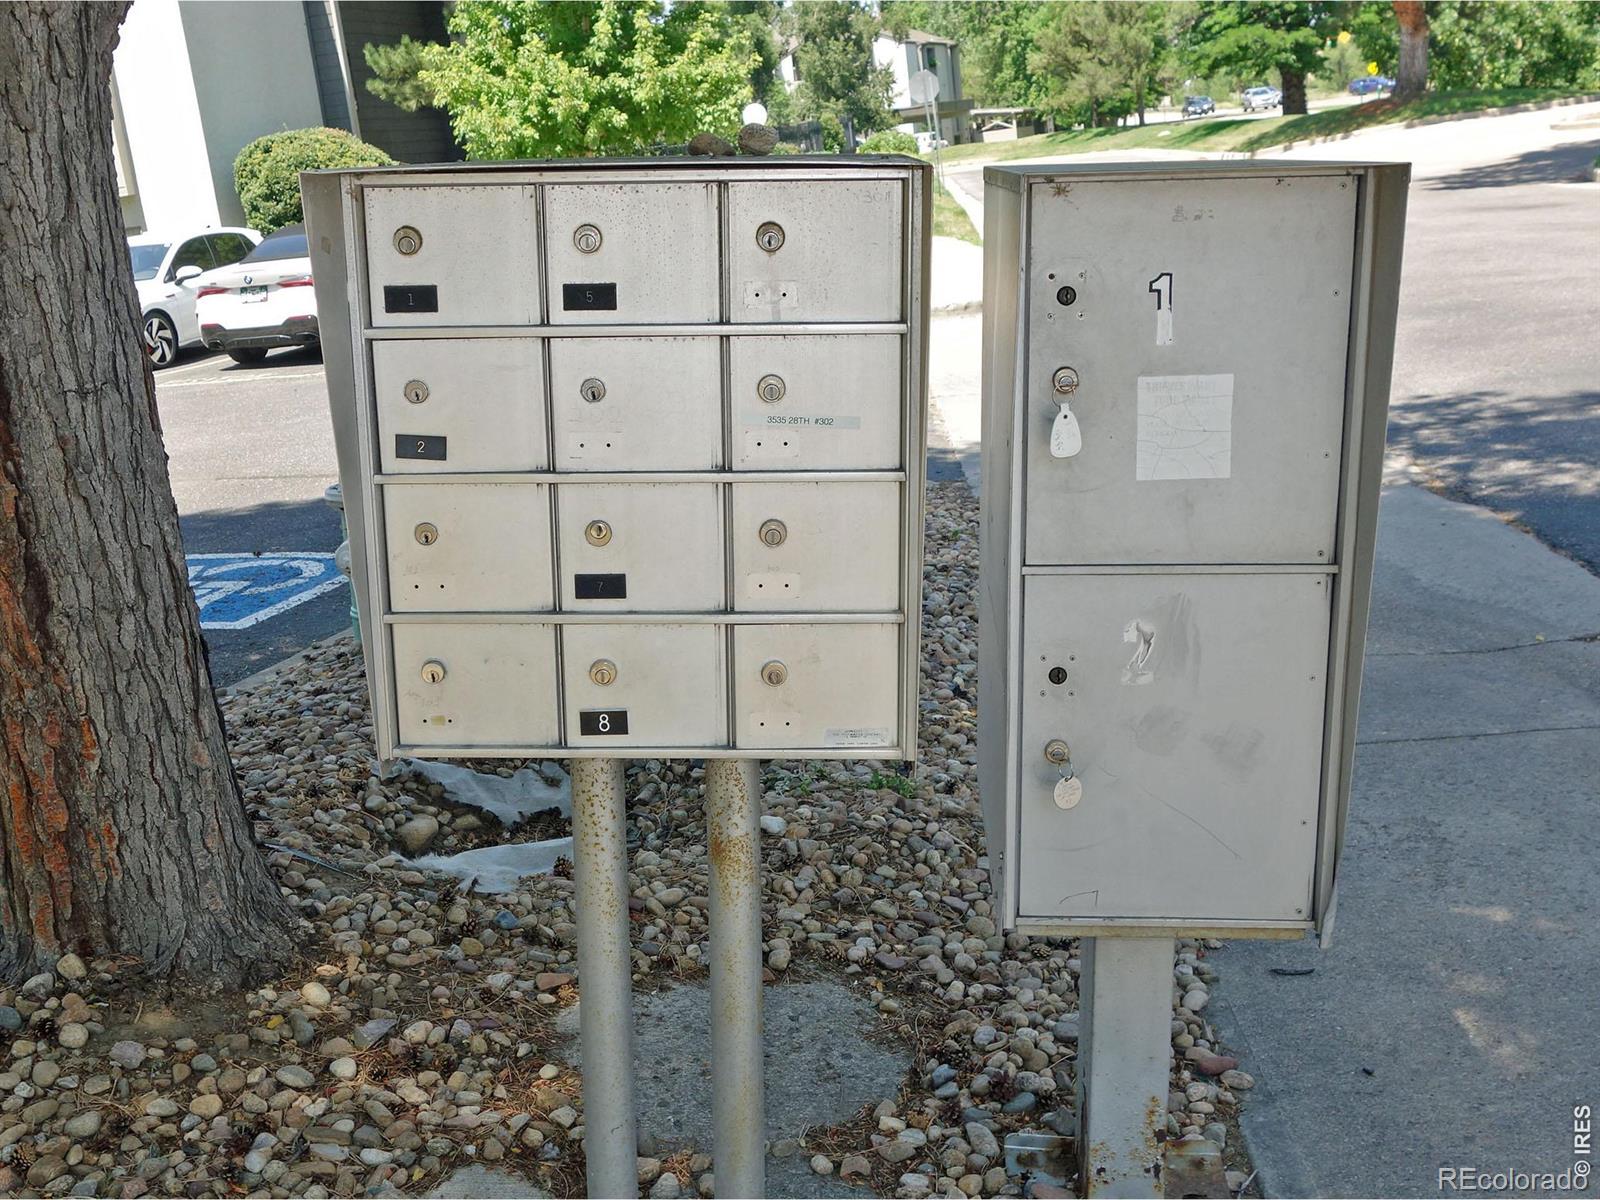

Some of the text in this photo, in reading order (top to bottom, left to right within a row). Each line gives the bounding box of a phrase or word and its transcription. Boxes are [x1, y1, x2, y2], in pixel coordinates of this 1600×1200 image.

[407, 293, 415, 306] 1
[586, 290, 594, 303] 5
[1148, 272, 1173, 346] 1
[767, 415, 834, 426] 3535 28TH #302
[417, 440, 425, 453] 2
[596, 581, 604, 593] 7
[599, 713, 610, 732] 8
